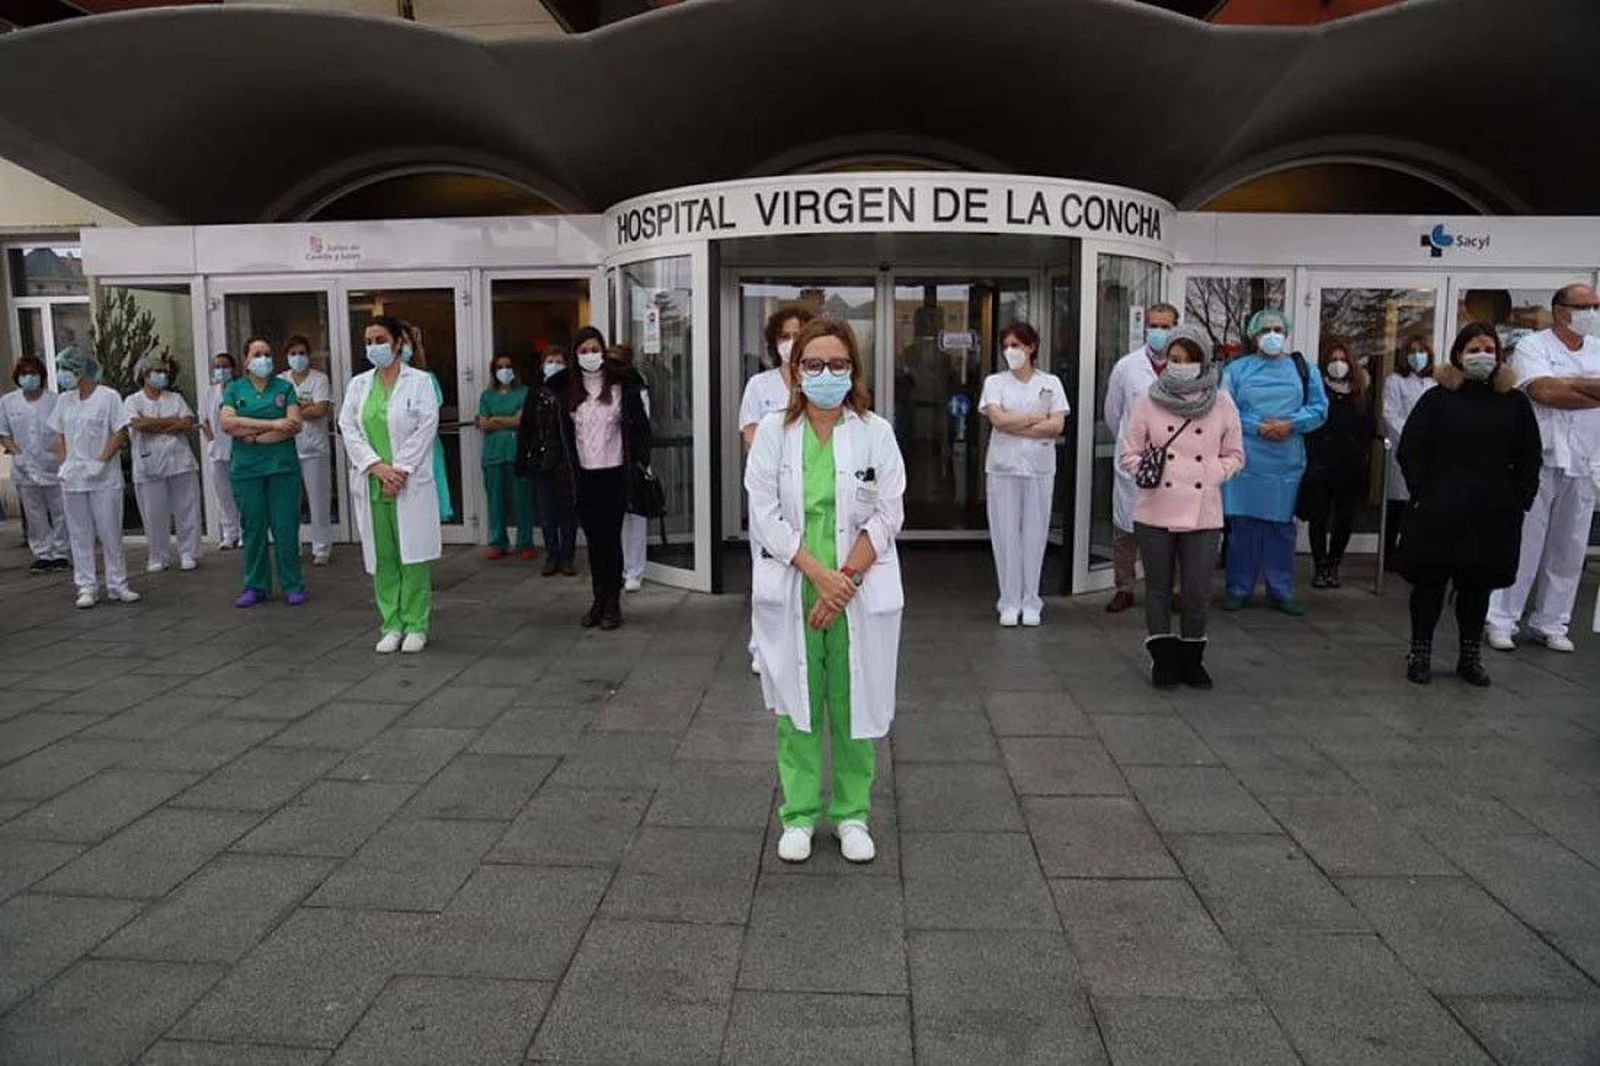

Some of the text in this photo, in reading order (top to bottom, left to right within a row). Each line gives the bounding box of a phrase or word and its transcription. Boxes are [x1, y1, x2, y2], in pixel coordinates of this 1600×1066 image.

[617, 187, 1161, 244] HOSPITAL VIRGEN DE LA CONCHA
[1456, 234, 1490, 250] Sacyl
